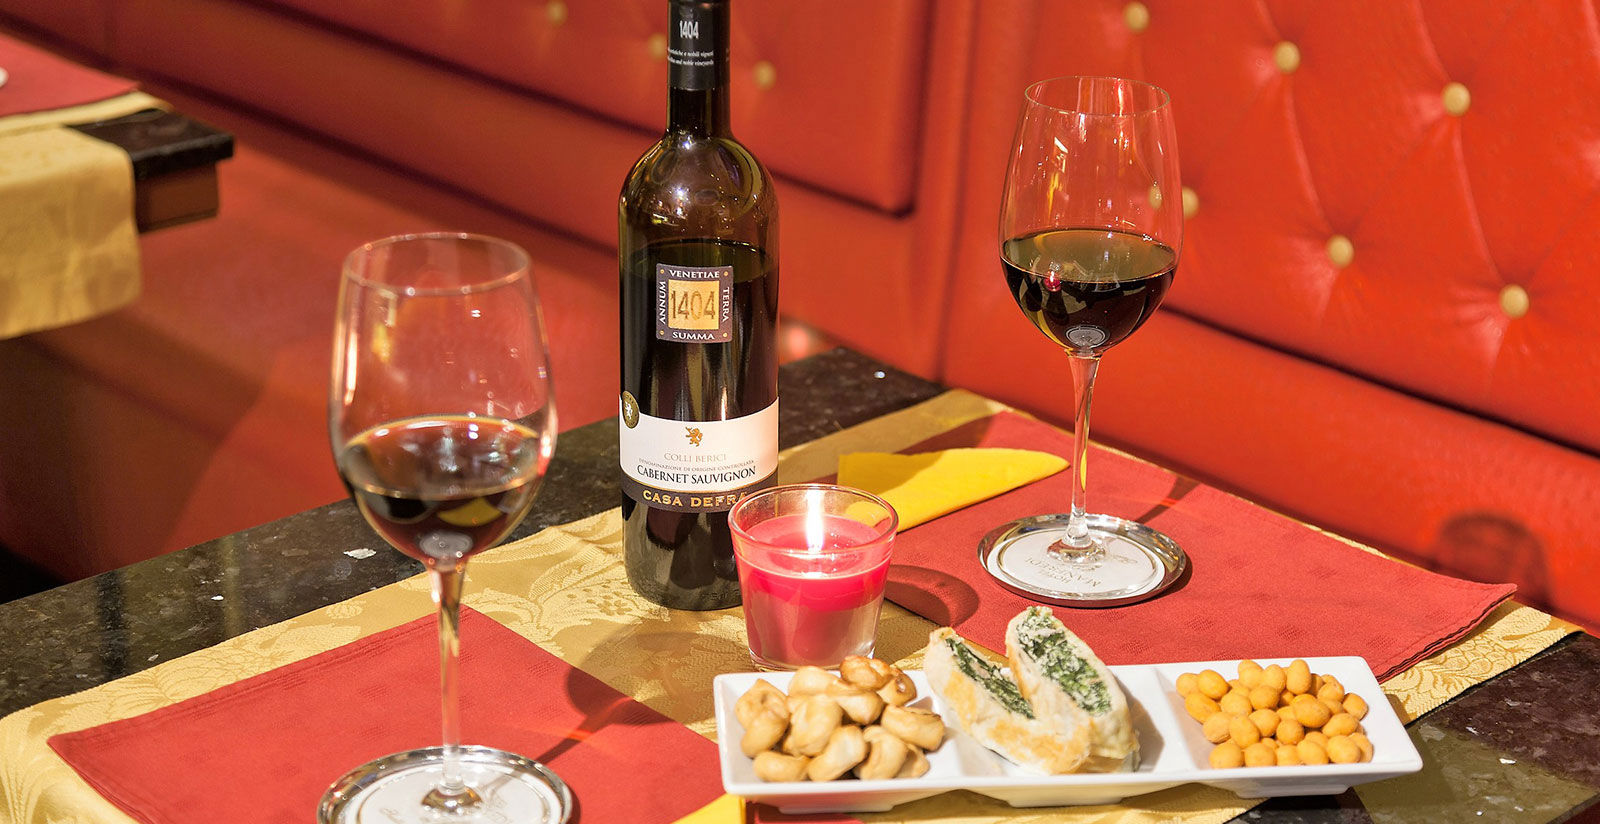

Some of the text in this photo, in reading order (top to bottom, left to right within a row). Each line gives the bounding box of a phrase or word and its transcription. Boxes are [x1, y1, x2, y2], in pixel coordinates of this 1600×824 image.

[680, 20, 699, 39] 1404
[669, 269, 720, 279] VENETIAE
[659, 281, 667, 325] ANNUM
[670, 290, 716, 320] 1404
[722, 286, 730, 323] TERRA
[672, 331, 715, 340] SUMMA
[663, 453, 727, 463] COLLI BERICI
[637, 464, 756, 484] CABERNET SAUVIGNON
[642, 489, 683, 507] CASA
